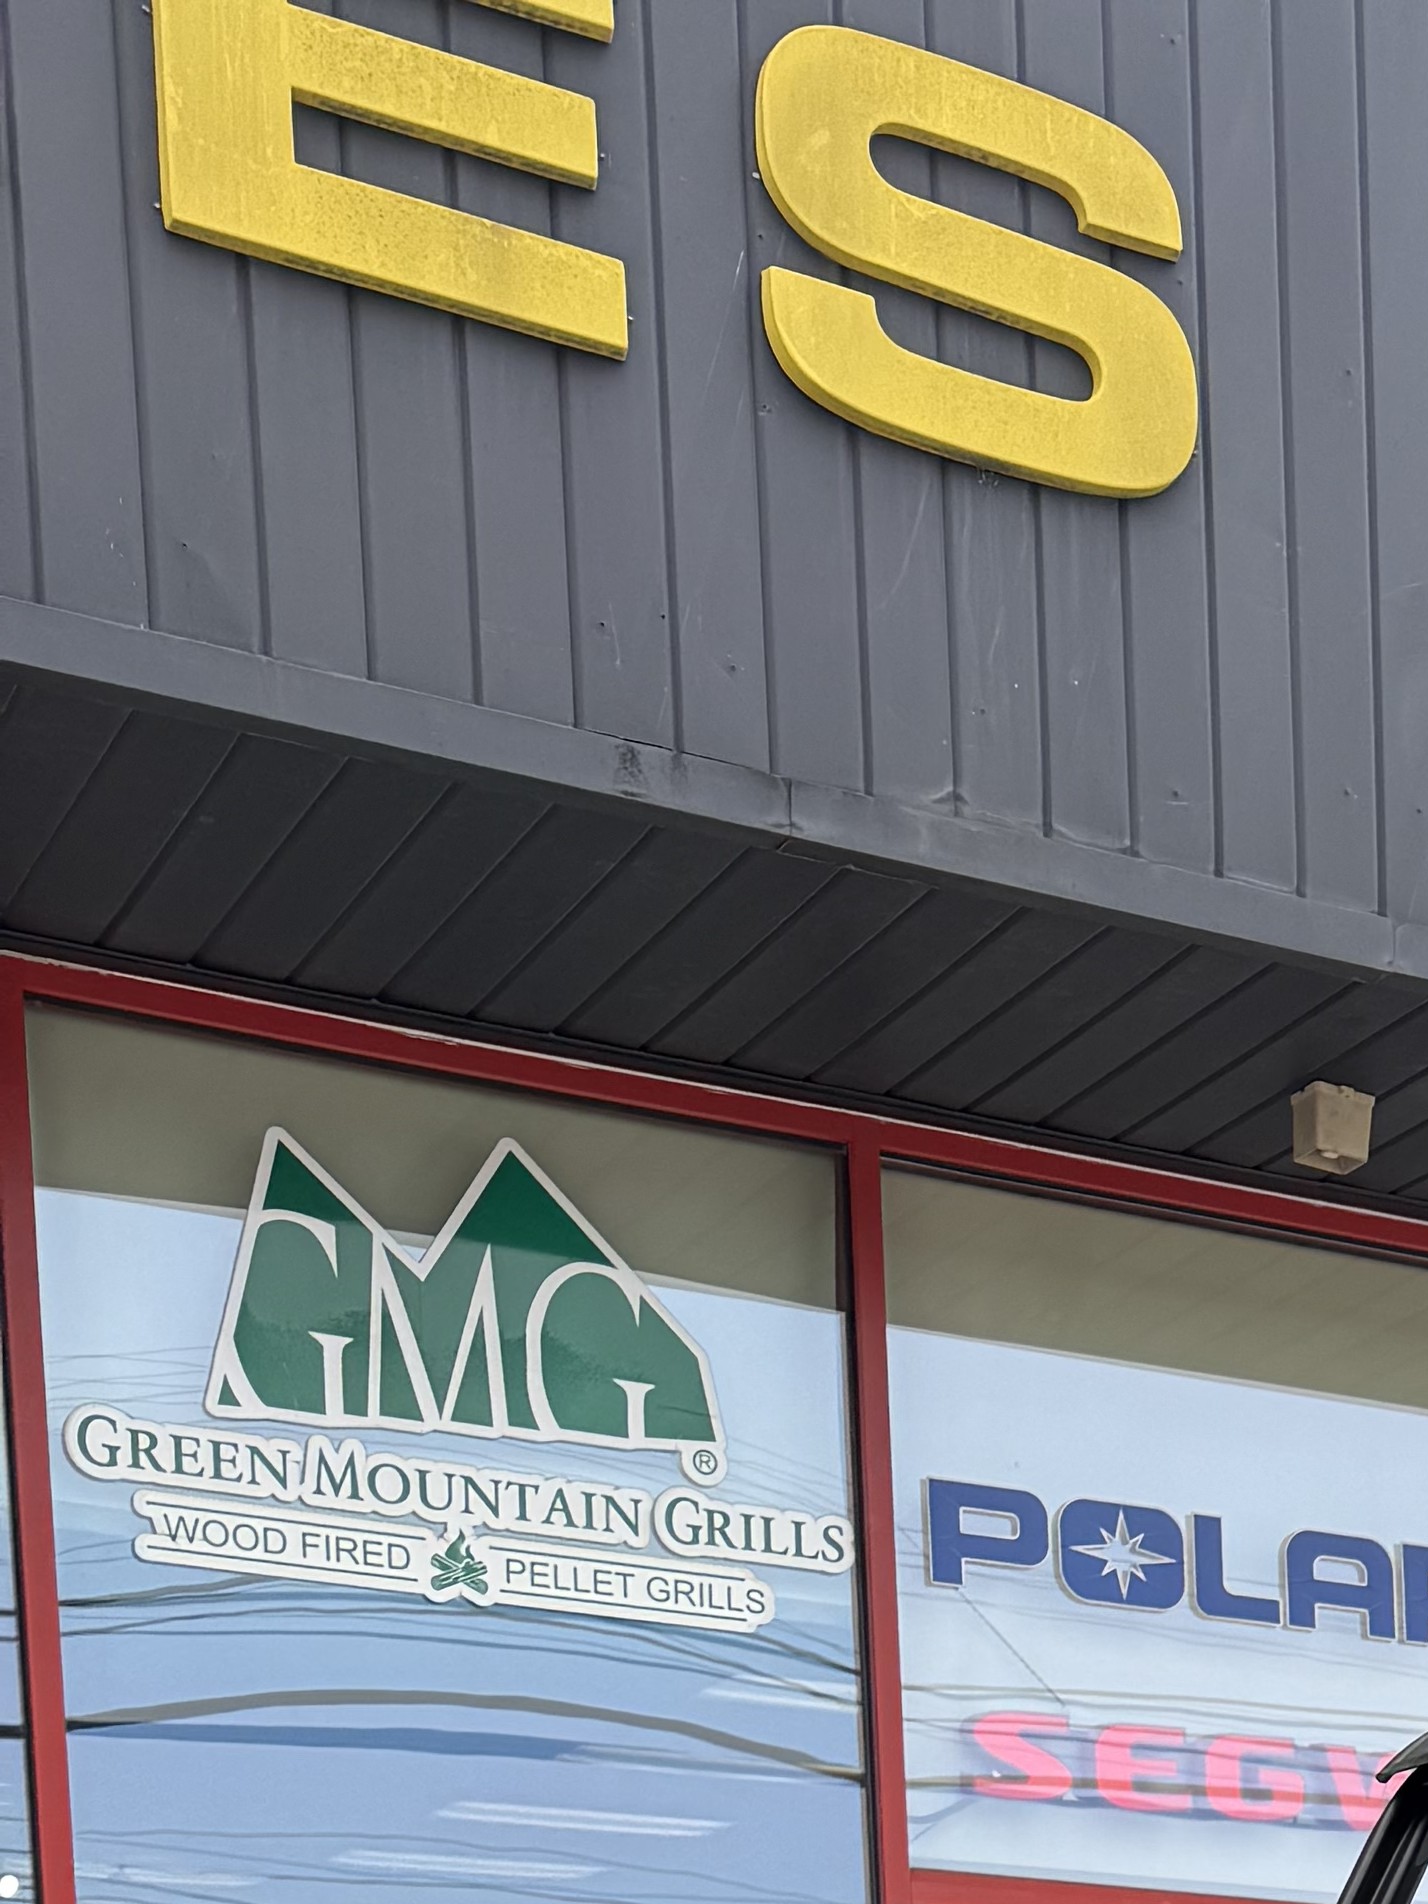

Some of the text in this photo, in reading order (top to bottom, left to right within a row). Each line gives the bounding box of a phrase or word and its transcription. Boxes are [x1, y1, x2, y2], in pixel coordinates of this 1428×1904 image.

[226, 1209, 655, 1440] GMG
[76, 1415, 846, 1566] GREEN MOUNTAIN GRILLS
[162, 1513, 767, 1616] WOOD FIRED PELLET GRILLS
